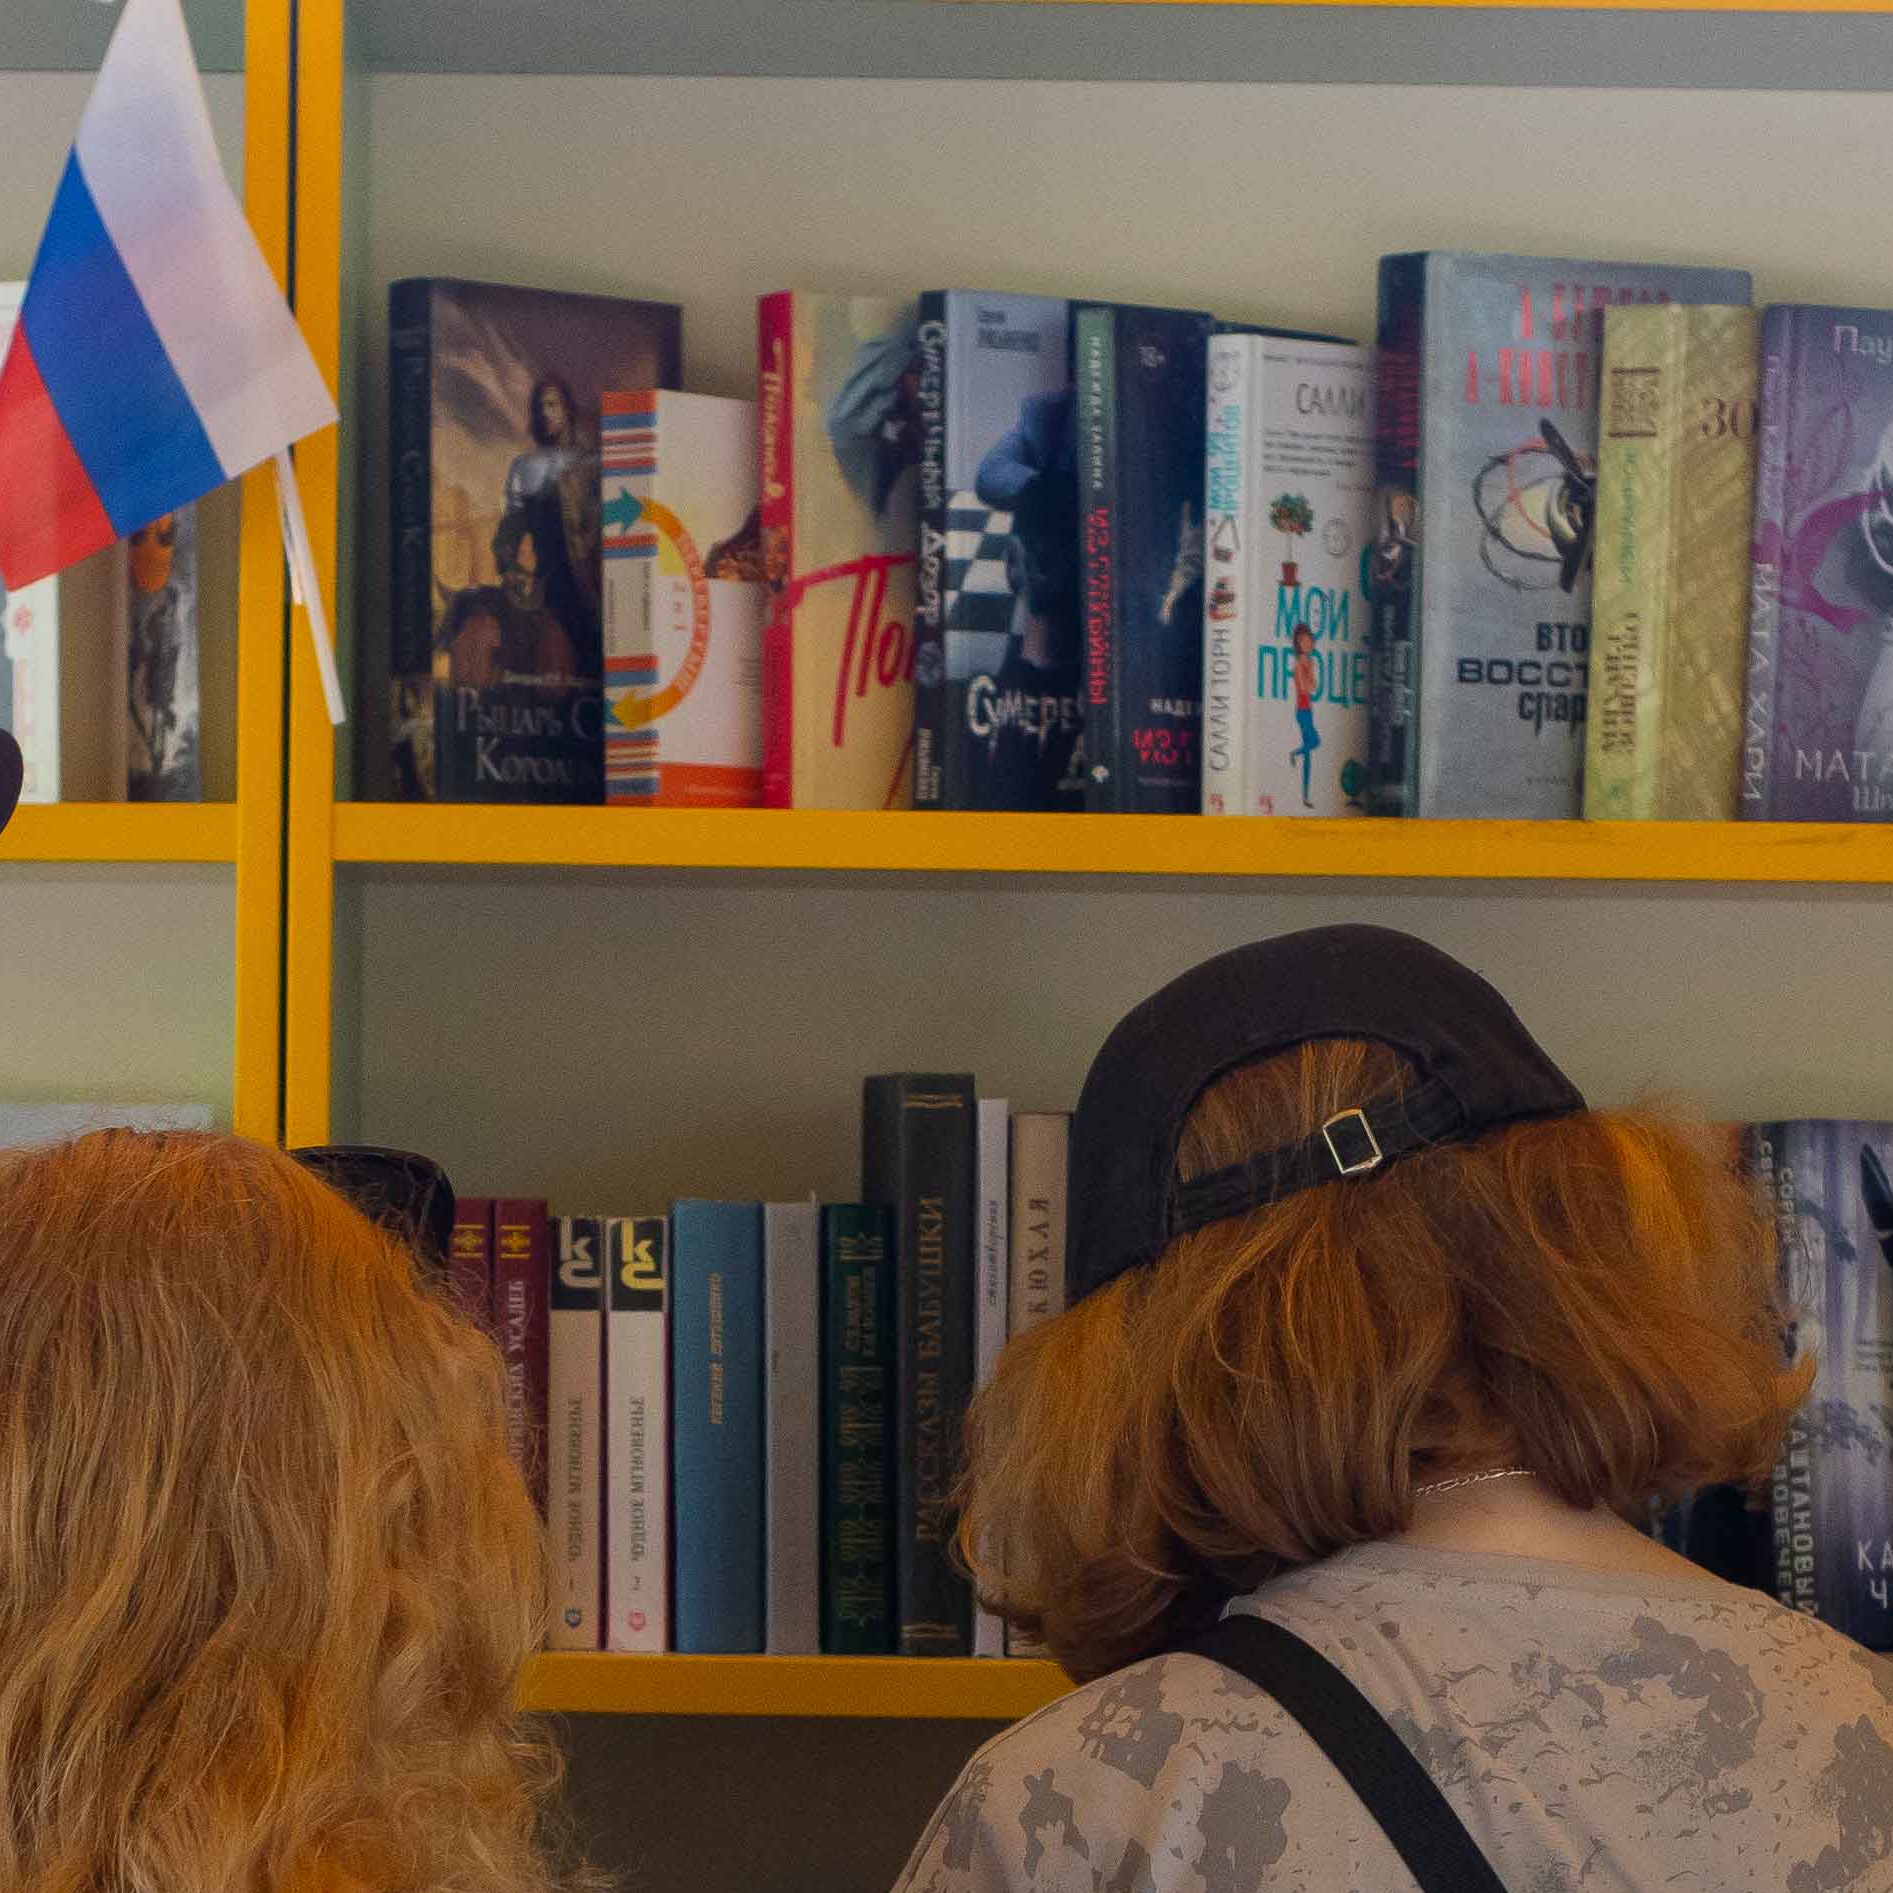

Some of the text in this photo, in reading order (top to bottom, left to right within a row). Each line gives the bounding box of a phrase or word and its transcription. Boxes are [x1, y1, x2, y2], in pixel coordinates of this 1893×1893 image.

[1275, 586, 1351, 643] МОИ
[1743, 564, 1777, 800] МАТА ХАРИ
[1209, 627, 1235, 773] САЛЛИ ТОРН
[1026, 1198, 1050, 1315] КЮХЛЯ
[914, 1197, 944, 1543] РАССКАЗЫ БАБУШКИ
[567, 1397, 583, 1494] МГНОВЕНЬЕ
[629, 1396, 646, 1562] ЧУДНОЕ МГНОВЕНЬЕ
